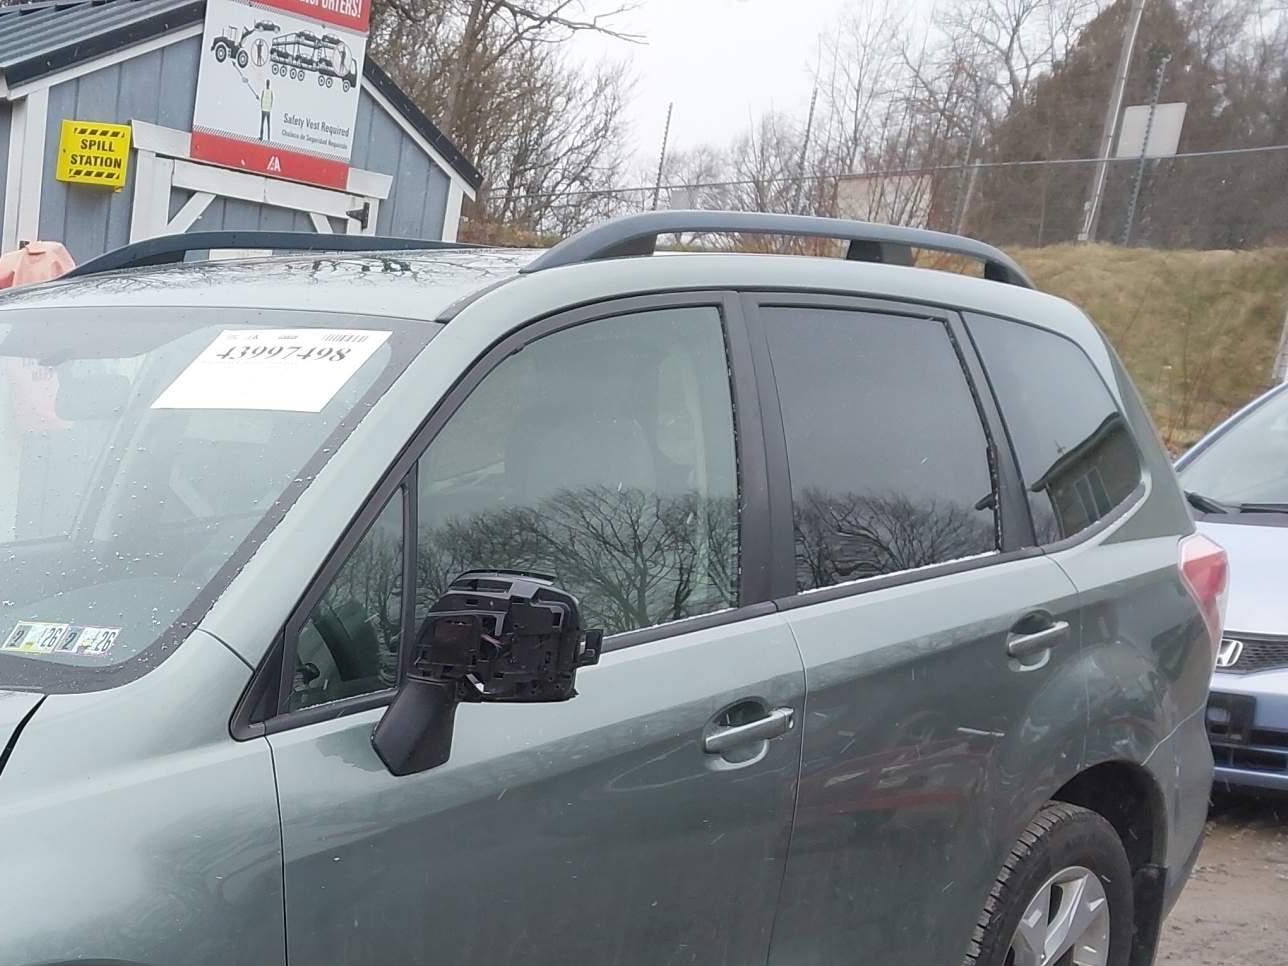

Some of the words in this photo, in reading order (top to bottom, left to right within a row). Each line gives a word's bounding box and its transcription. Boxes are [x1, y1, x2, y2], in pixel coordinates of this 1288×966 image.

[283, 113, 305, 129] Safety
[306, 118, 320, 130] Vest
[321, 121, 350, 137] Required
[80, 138, 115, 152] SPILL
[70, 154, 122, 169] STATION
[216, 345, 352, 362] 43997498
